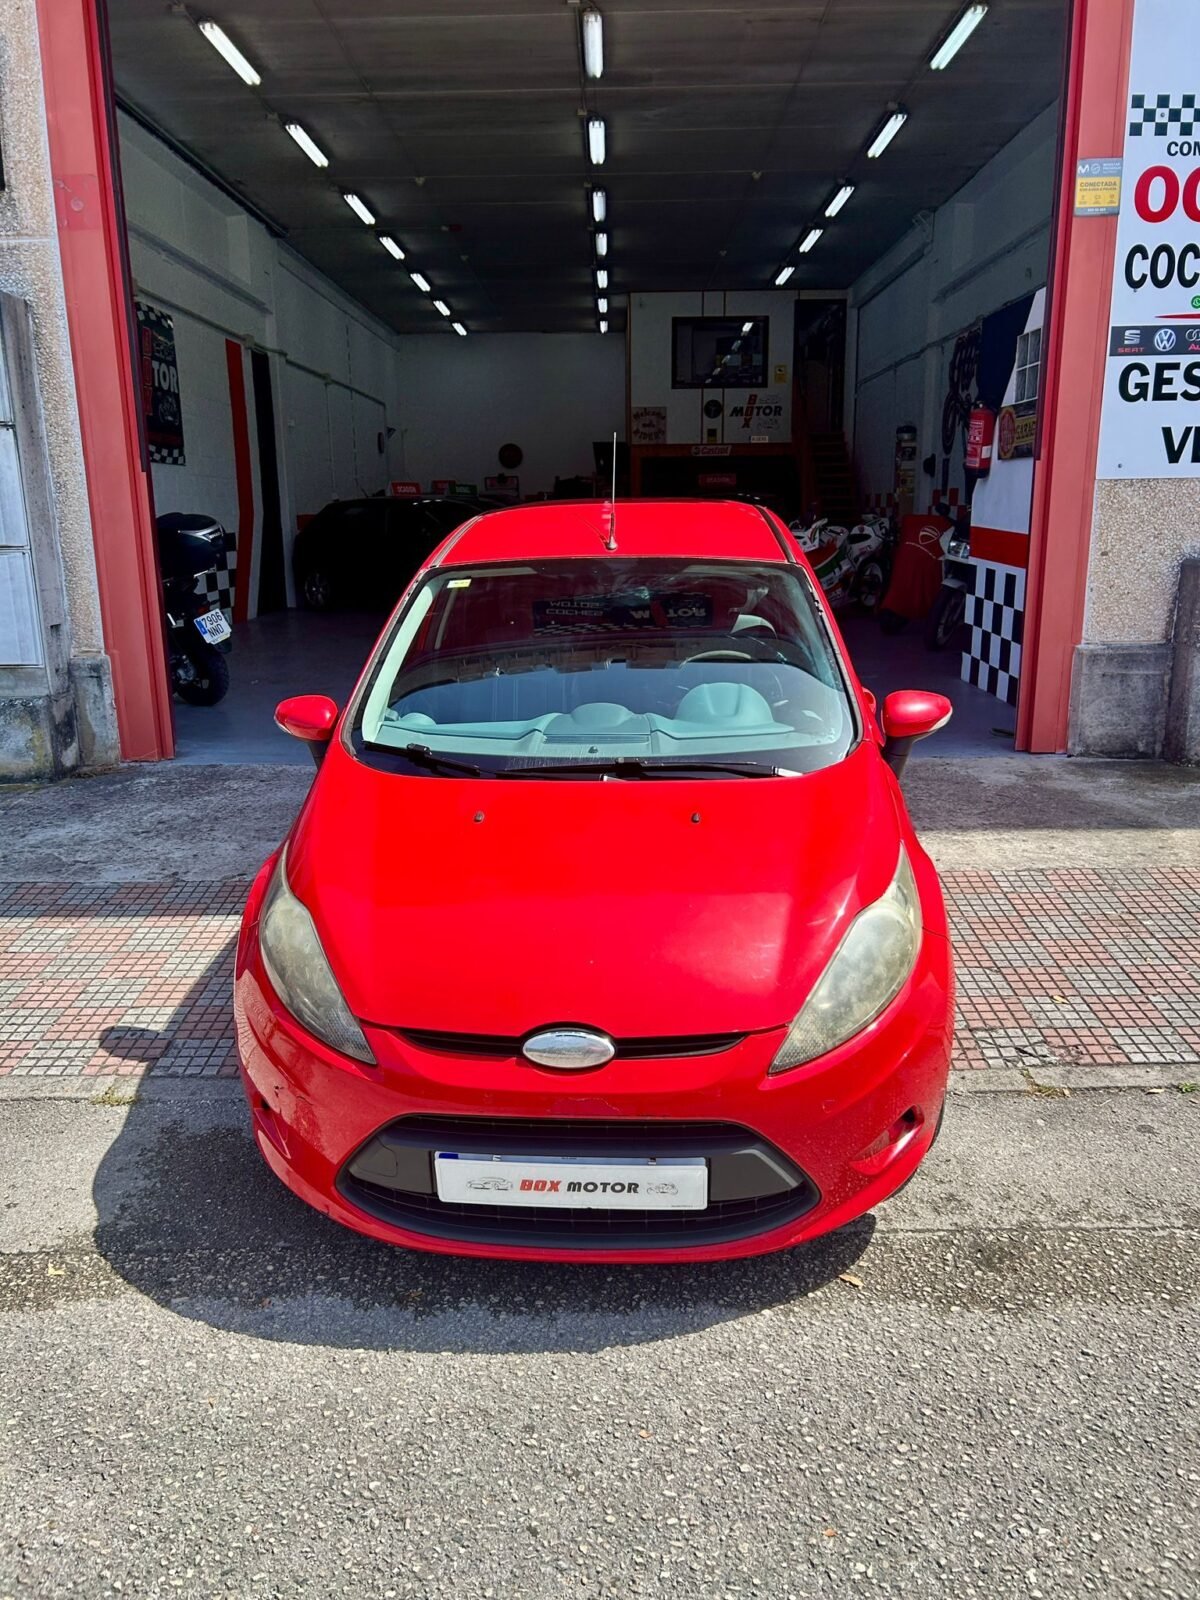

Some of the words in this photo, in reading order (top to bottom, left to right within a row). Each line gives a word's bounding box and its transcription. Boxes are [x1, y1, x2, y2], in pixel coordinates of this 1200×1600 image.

[1125, 243, 1200, 289] COC
[1118, 362, 1200, 402] GES
[730, 405, 782, 417] MOTOR
[201, 612, 223, 629] 7906
[519, 1179, 562, 1192] BOX
[566, 1181, 640, 1194] MOTOR
